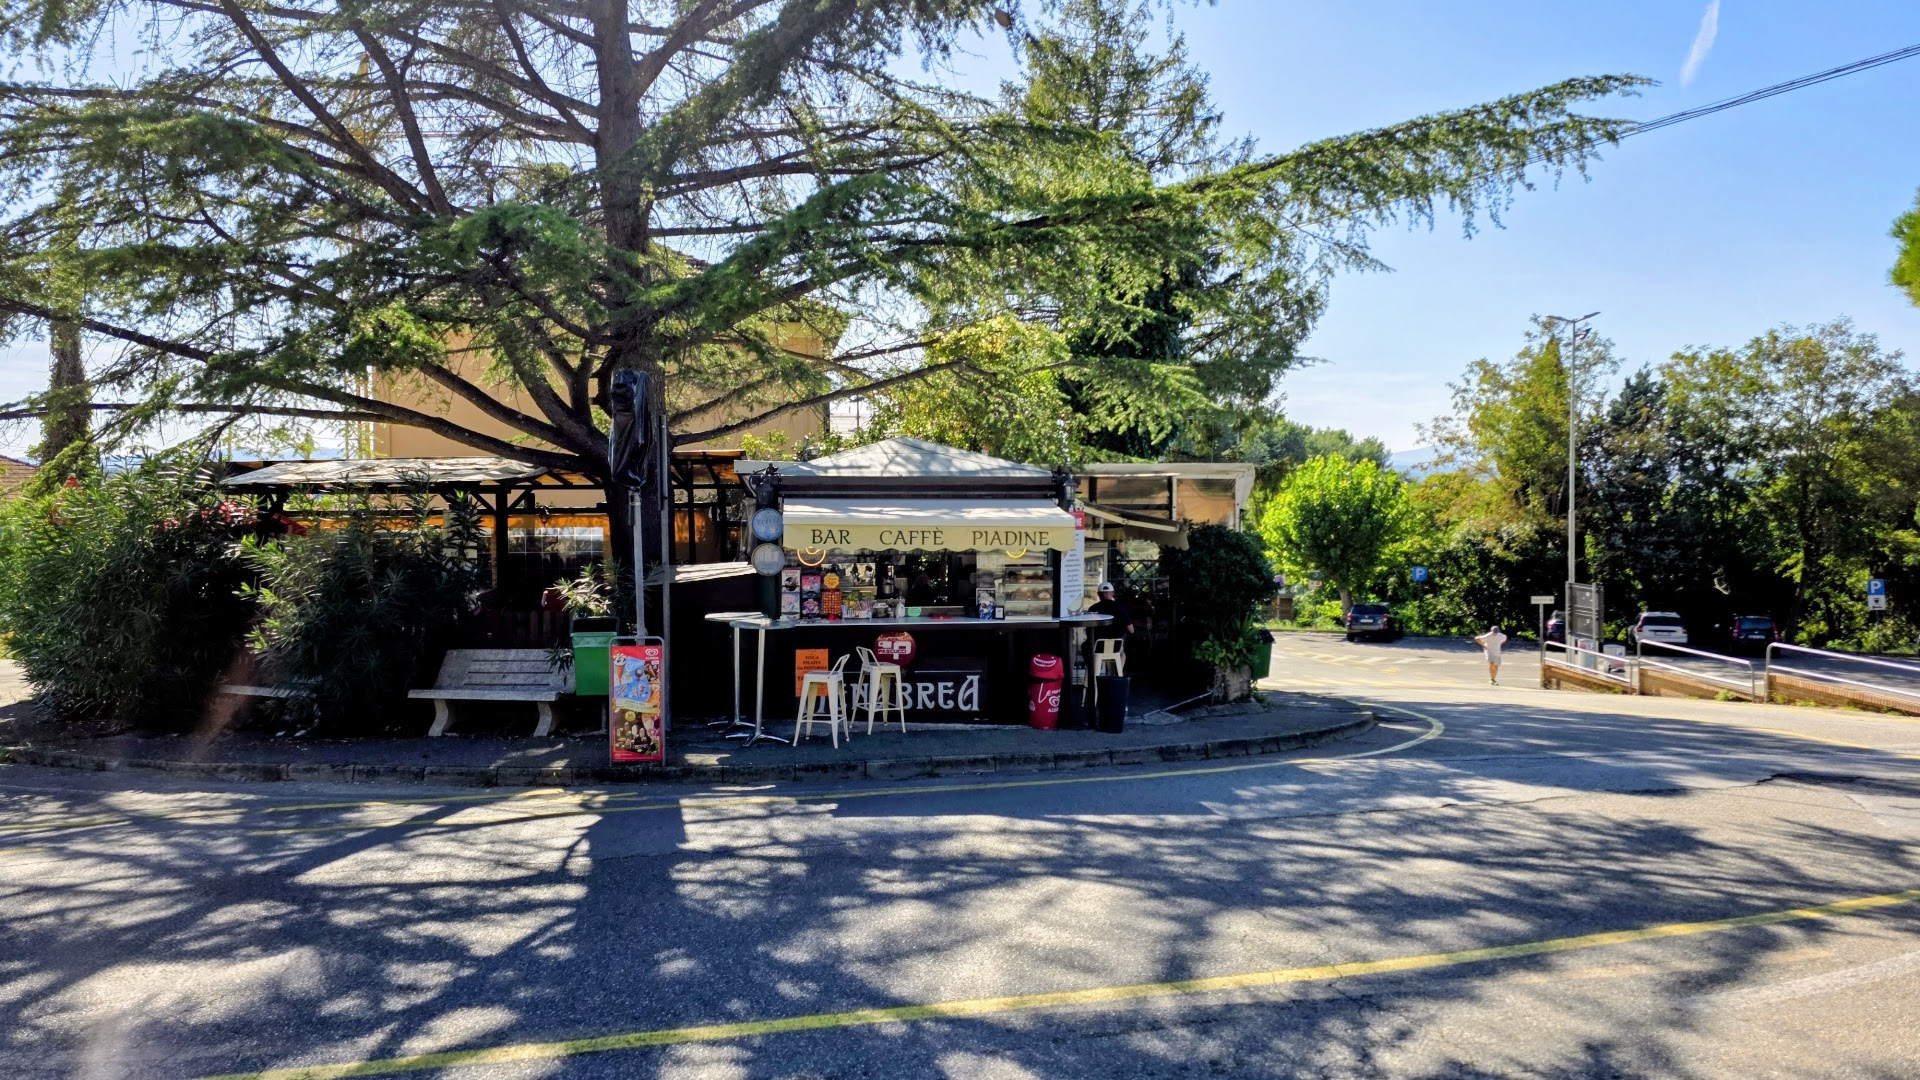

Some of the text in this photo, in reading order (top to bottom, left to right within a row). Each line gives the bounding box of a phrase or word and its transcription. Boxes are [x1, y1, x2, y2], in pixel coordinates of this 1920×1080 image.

[811, 527, 1050, 546] BAR CAFFÈ PIADINE
[1415, 568, 1425, 579] P
[1870, 581, 1881, 593] P
